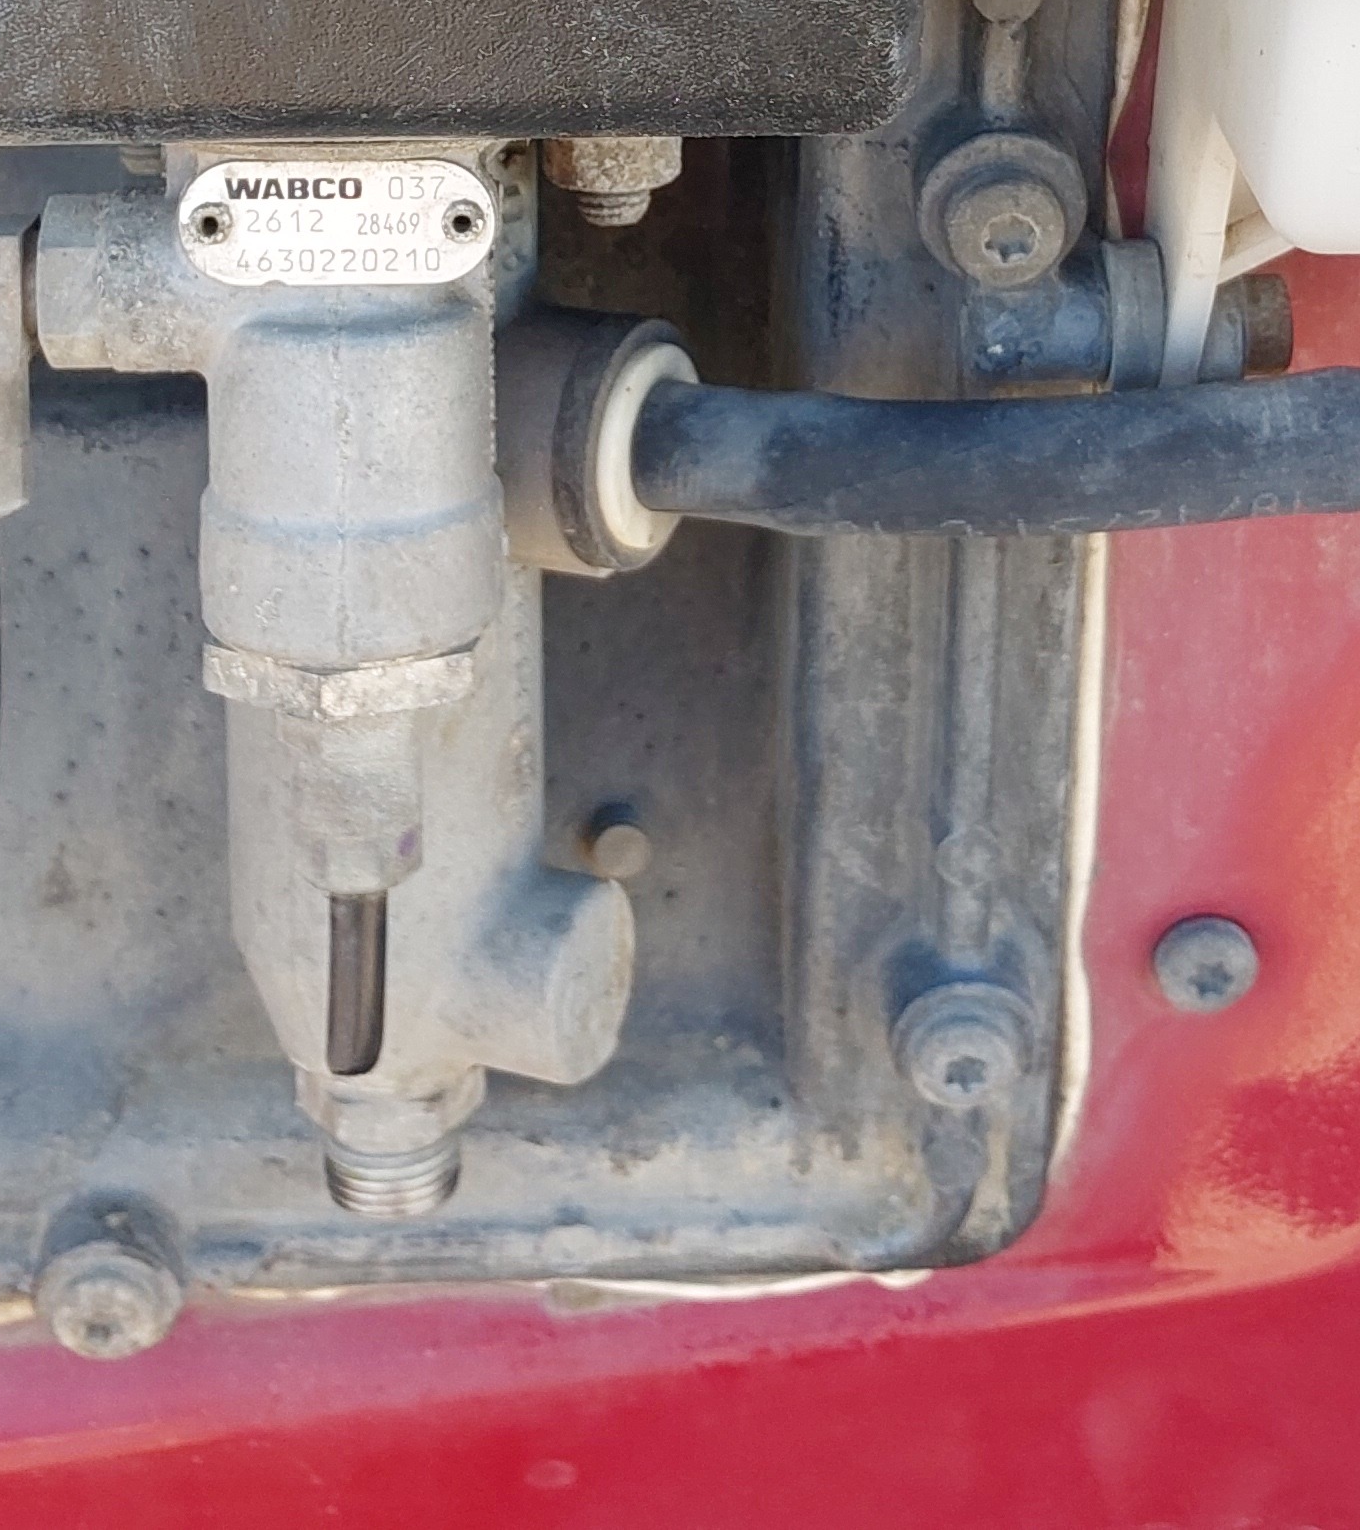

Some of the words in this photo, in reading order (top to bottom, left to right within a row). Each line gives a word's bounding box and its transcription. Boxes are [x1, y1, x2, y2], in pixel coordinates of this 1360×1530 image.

[224, 177, 363, 200] WABCO
[387, 175, 446, 200] 037
[245, 208, 324, 233] 2612
[356, 211, 421, 236] 28469
[235, 247, 441, 273] 4630220210
